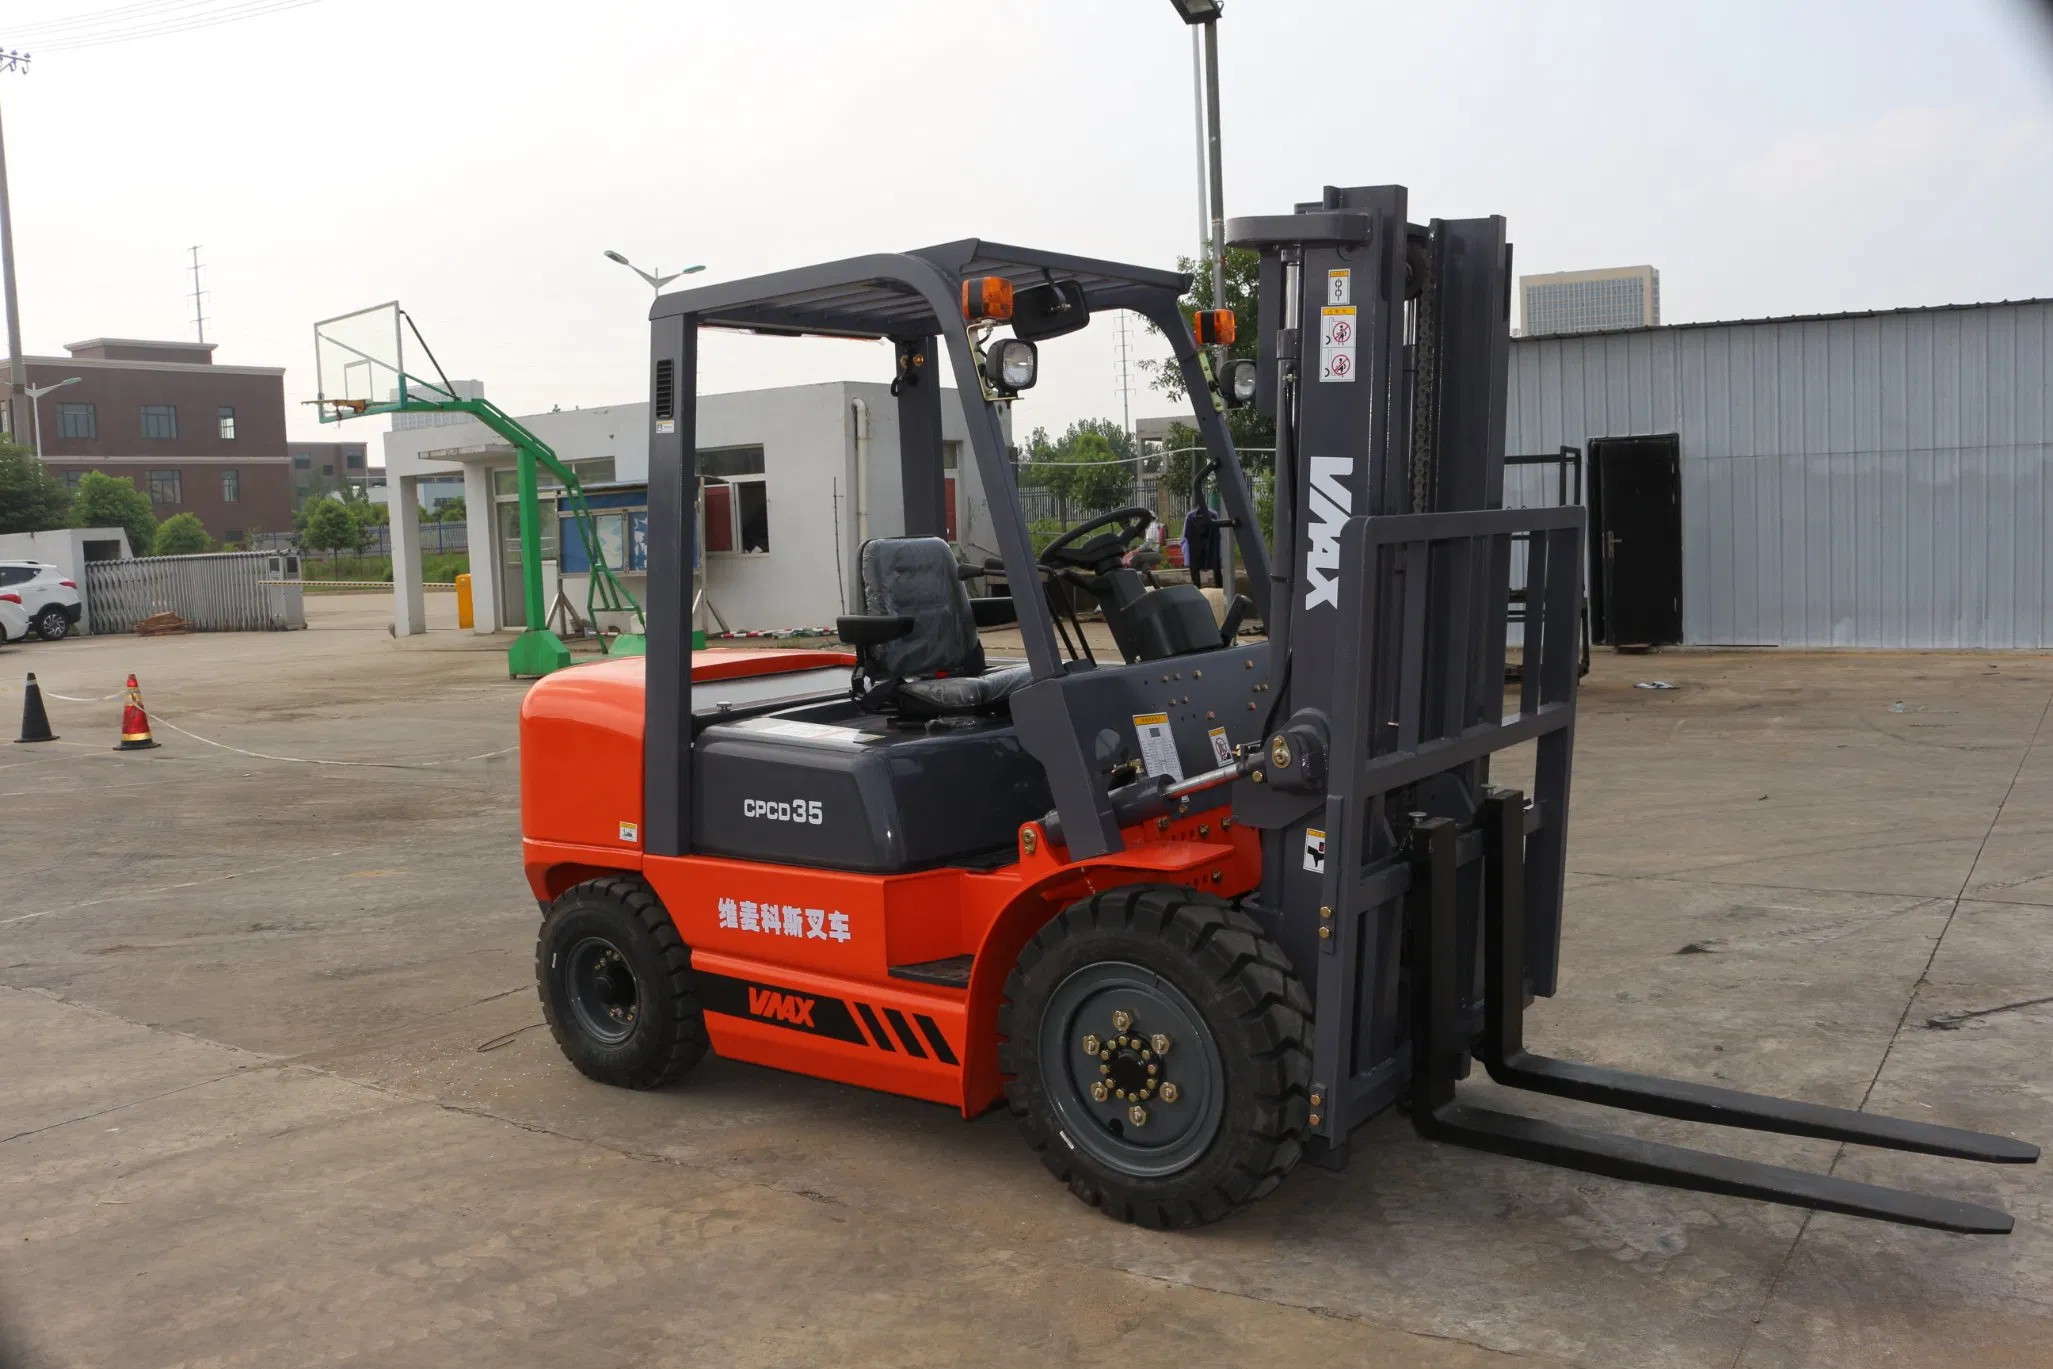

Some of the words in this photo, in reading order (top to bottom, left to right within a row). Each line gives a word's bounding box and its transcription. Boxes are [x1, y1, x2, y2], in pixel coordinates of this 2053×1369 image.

[1305, 456, 1354, 611] VMAX
[717, 897, 852, 943] 维麦科斯叉车
[748, 986, 816, 1029] VMAX
